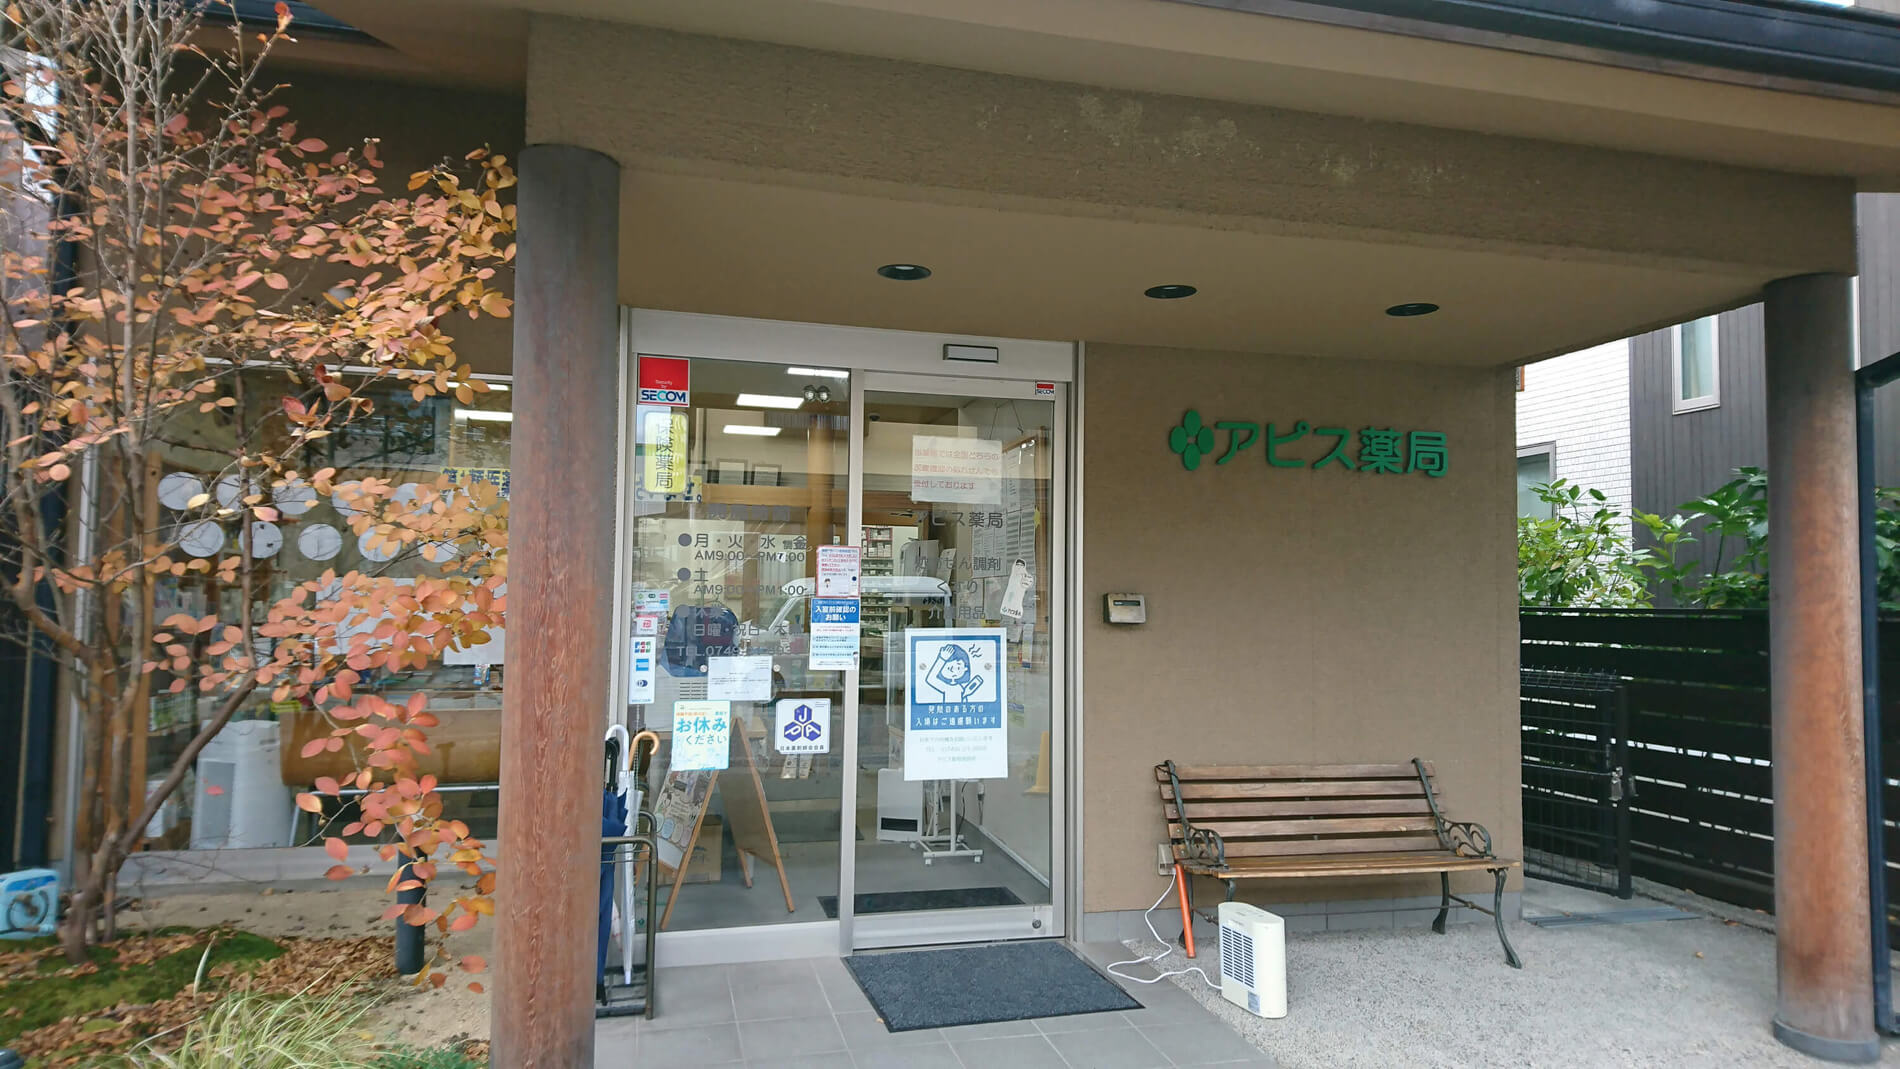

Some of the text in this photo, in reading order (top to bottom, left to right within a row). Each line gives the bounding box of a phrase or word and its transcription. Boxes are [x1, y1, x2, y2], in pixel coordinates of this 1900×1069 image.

[641, 390, 686, 402] SECOM
[1214, 420, 1449, 478] アピス薬局
[693, 567, 709, 583] 土
[676, 717, 727, 734] お休み
[685, 734, 727, 745] ください
